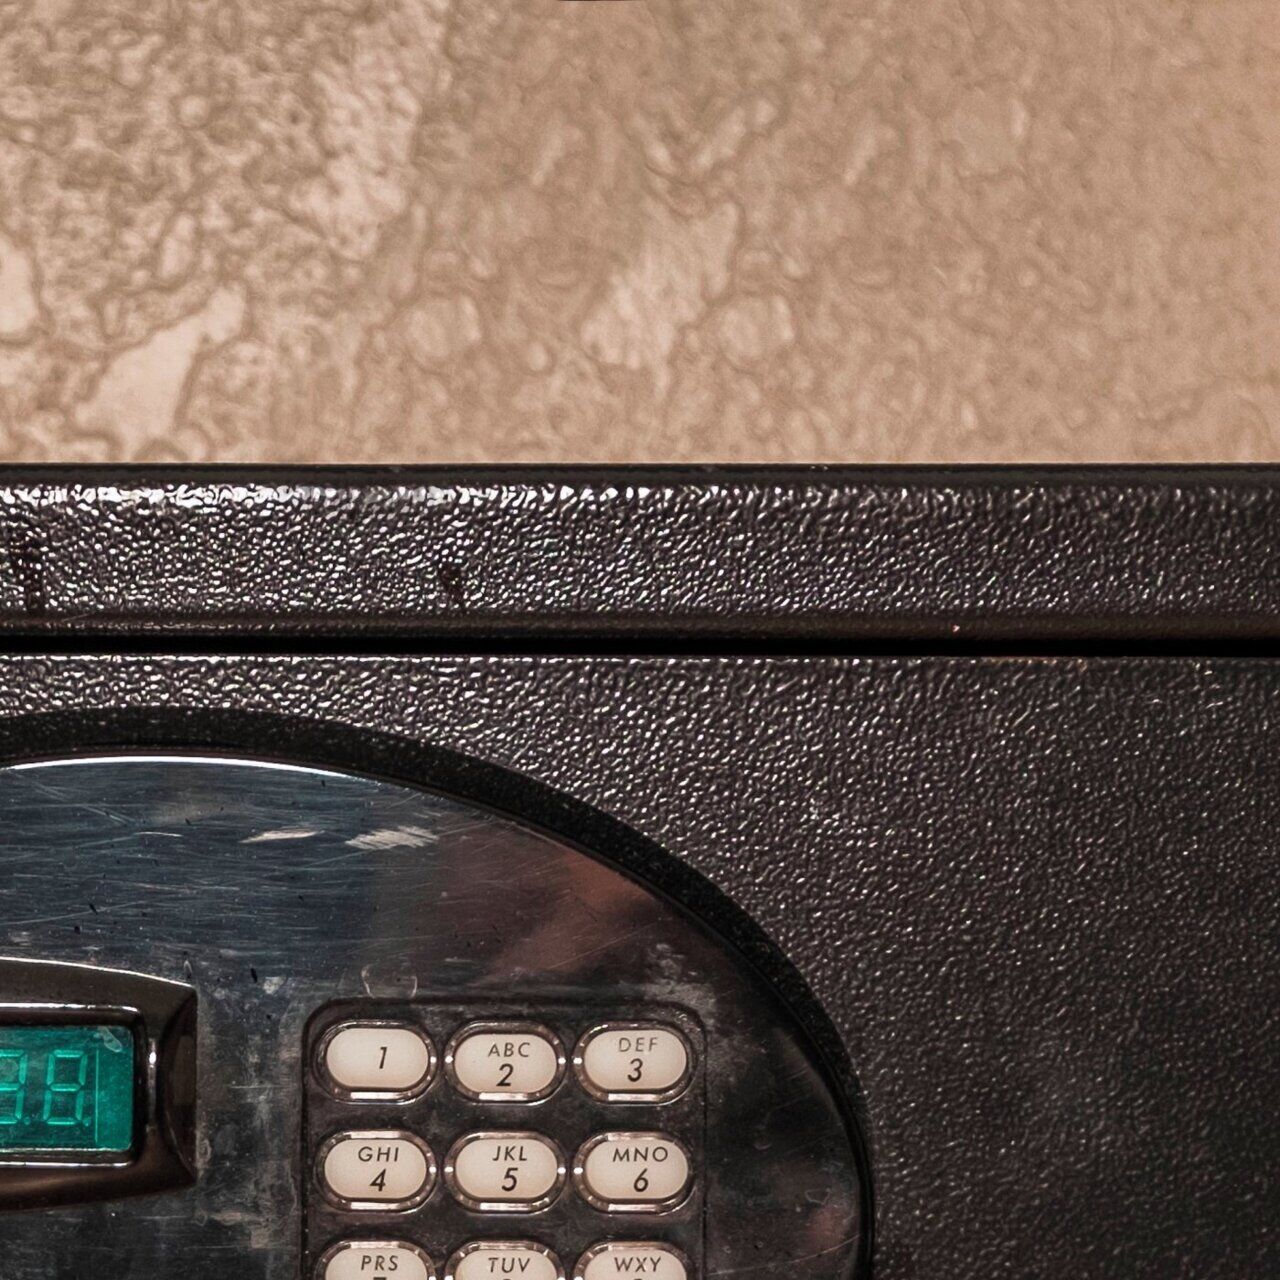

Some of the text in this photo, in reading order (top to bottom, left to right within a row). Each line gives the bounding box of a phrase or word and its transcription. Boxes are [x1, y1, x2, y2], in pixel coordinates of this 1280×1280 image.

[487, 1042, 530, 1058] ABC
[618, 1037, 659, 1052] DEF
[378, 1046, 388, 1069] 1
[496, 1064, 514, 1087] 2
[627, 1058, 644, 1082] 3
[357, 1146, 399, 1163] GHI
[492, 1146, 527, 1162] JKL
[612, 1147, 668, 1162] MNO
[369, 1169, 387, 1192] 4
[501, 1167, 519, 1192] 5
[633, 1170, 650, 1192] 6
[360, 1255, 399, 1271] PRS
[488, 1257, 530, 1273] TUV
[614, 1257, 662, 1272] WXY
